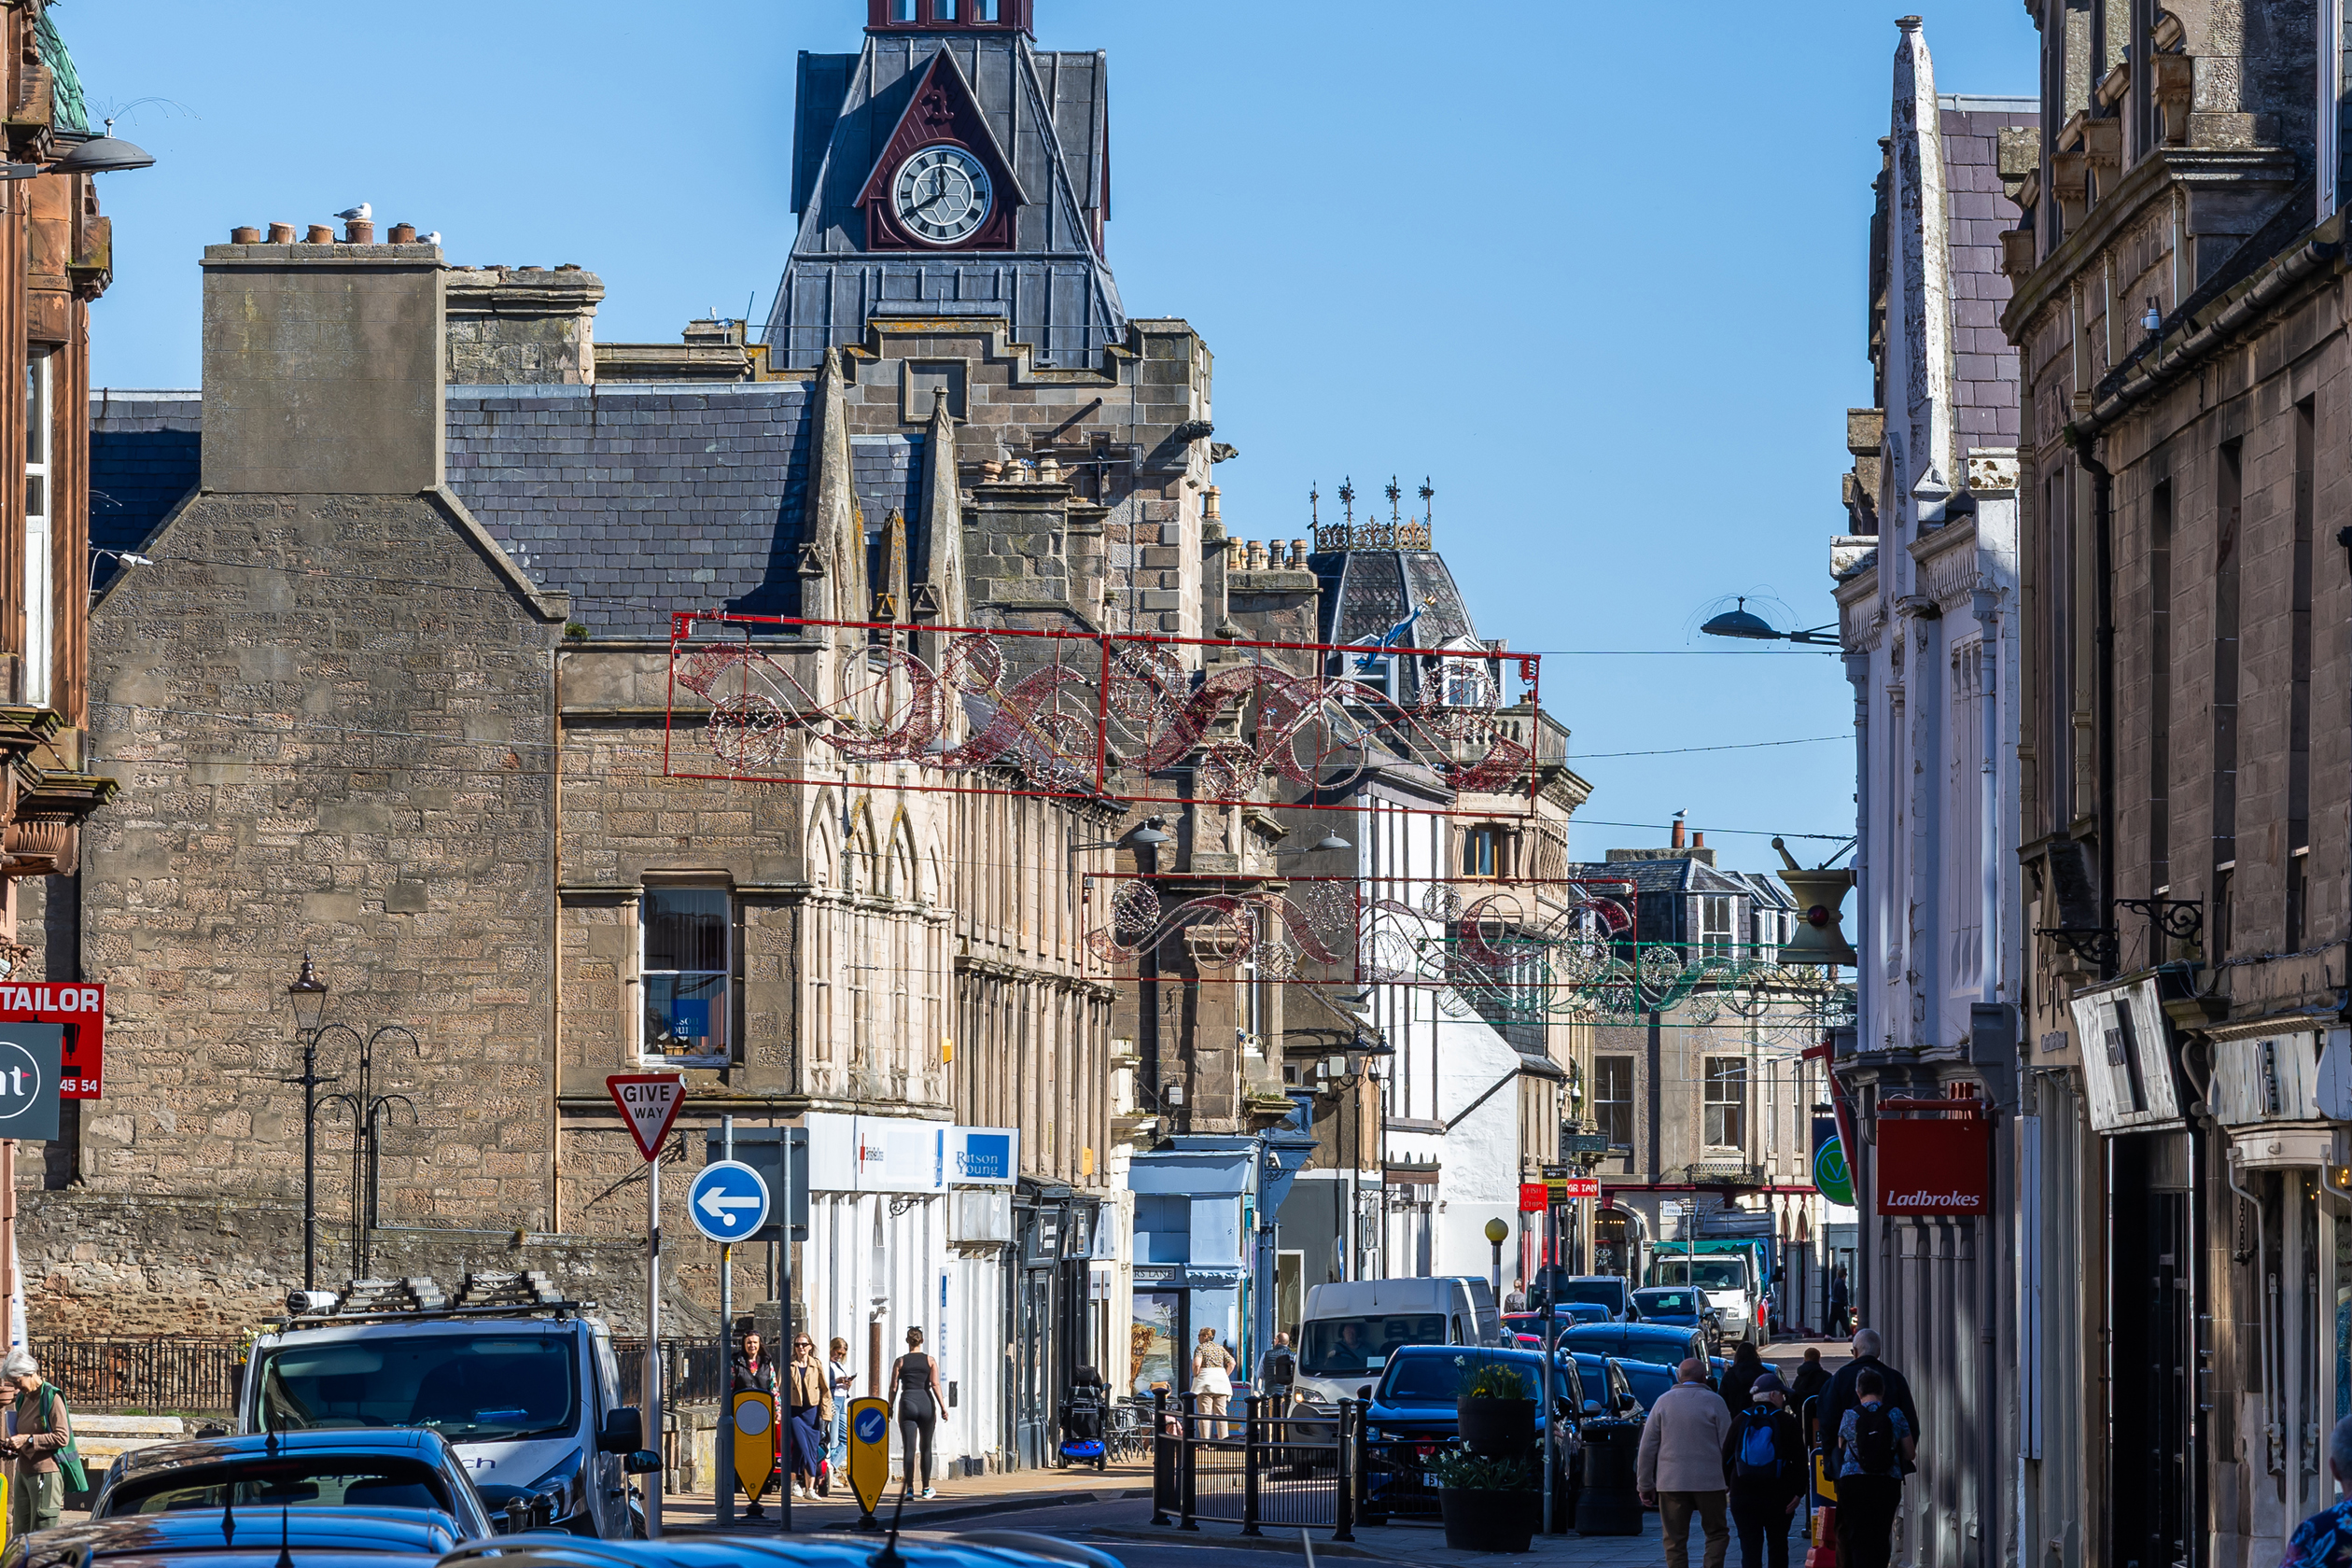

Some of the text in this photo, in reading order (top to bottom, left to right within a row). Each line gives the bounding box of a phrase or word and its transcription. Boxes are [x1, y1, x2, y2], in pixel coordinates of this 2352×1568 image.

[0, 987, 100, 1012] TAILOR
[81, 1080, 97, 1092] 54
[623, 1085, 671, 1102] GIVE
[635, 1107, 665, 1119] WAY
[956, 1151, 998, 1165] Ritson
[957, 1161, 998, 1179] Young
[1886, 1190, 1980, 1206] Ladbrokes
[1149, 1269, 1172, 1278] LANE
